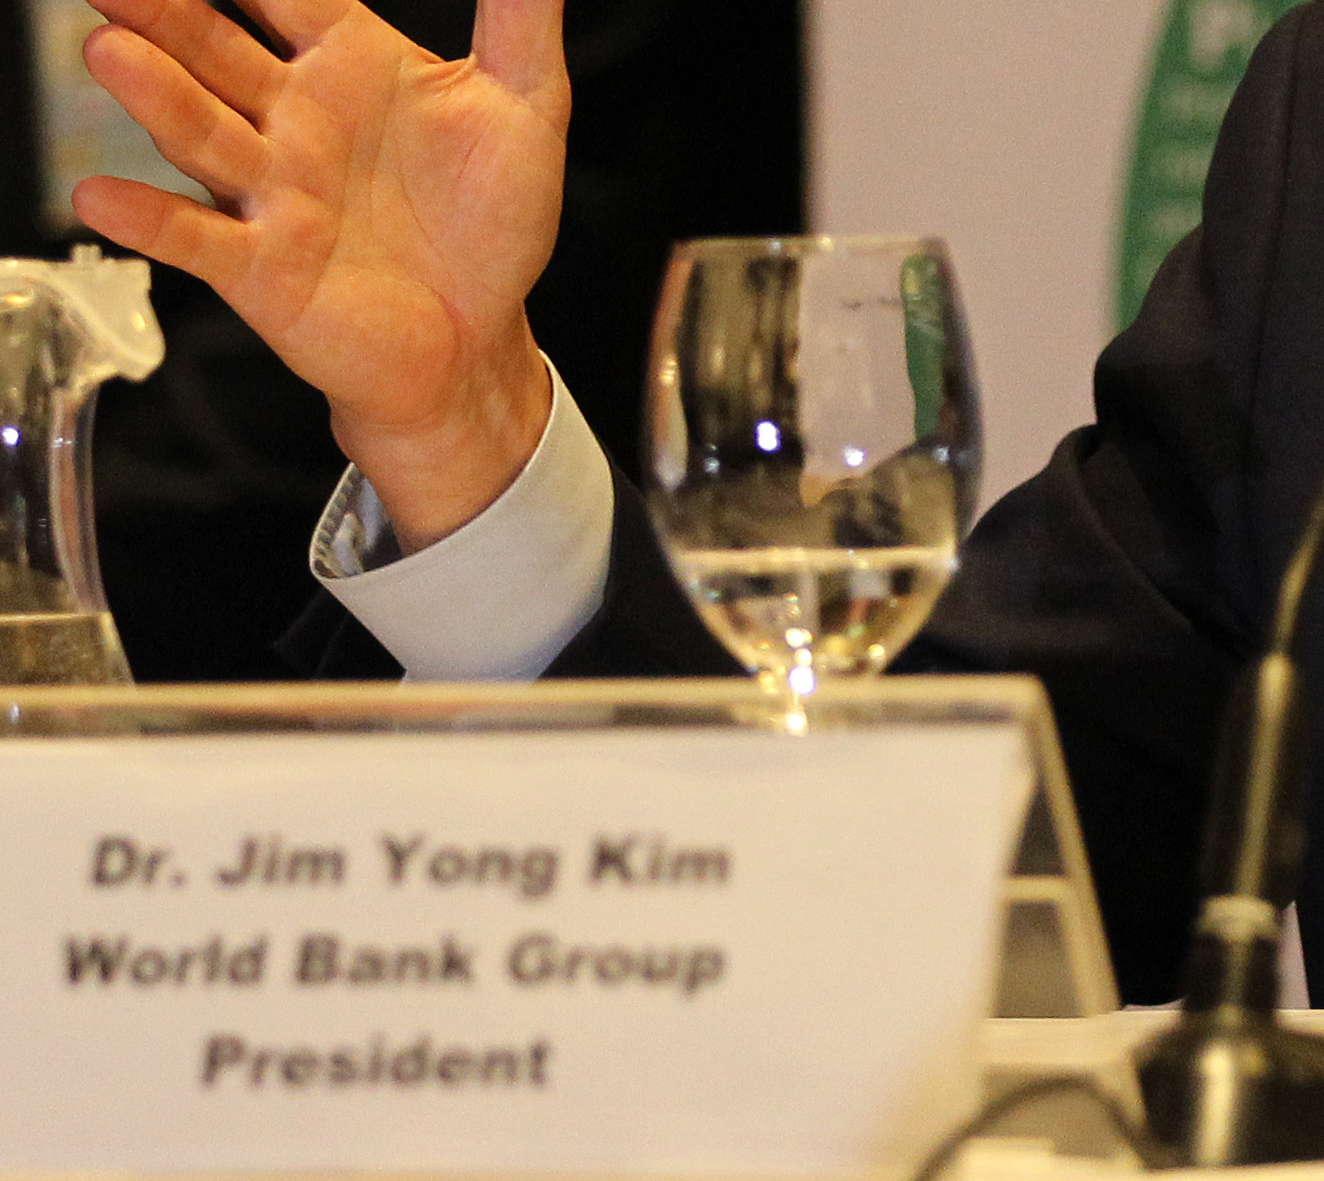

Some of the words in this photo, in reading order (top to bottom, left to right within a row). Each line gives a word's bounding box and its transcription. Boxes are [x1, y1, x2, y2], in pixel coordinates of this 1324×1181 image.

[89, 836, 187, 889] Dr.
[215, 836, 347, 889] Jim
[382, 836, 559, 900] Yong
[587, 834, 732, 887] Kim
[62, 934, 267, 987] World
[293, 935, 473, 987] Bank
[505, 934, 726, 996] Group
[200, 1035, 550, 1089] President
